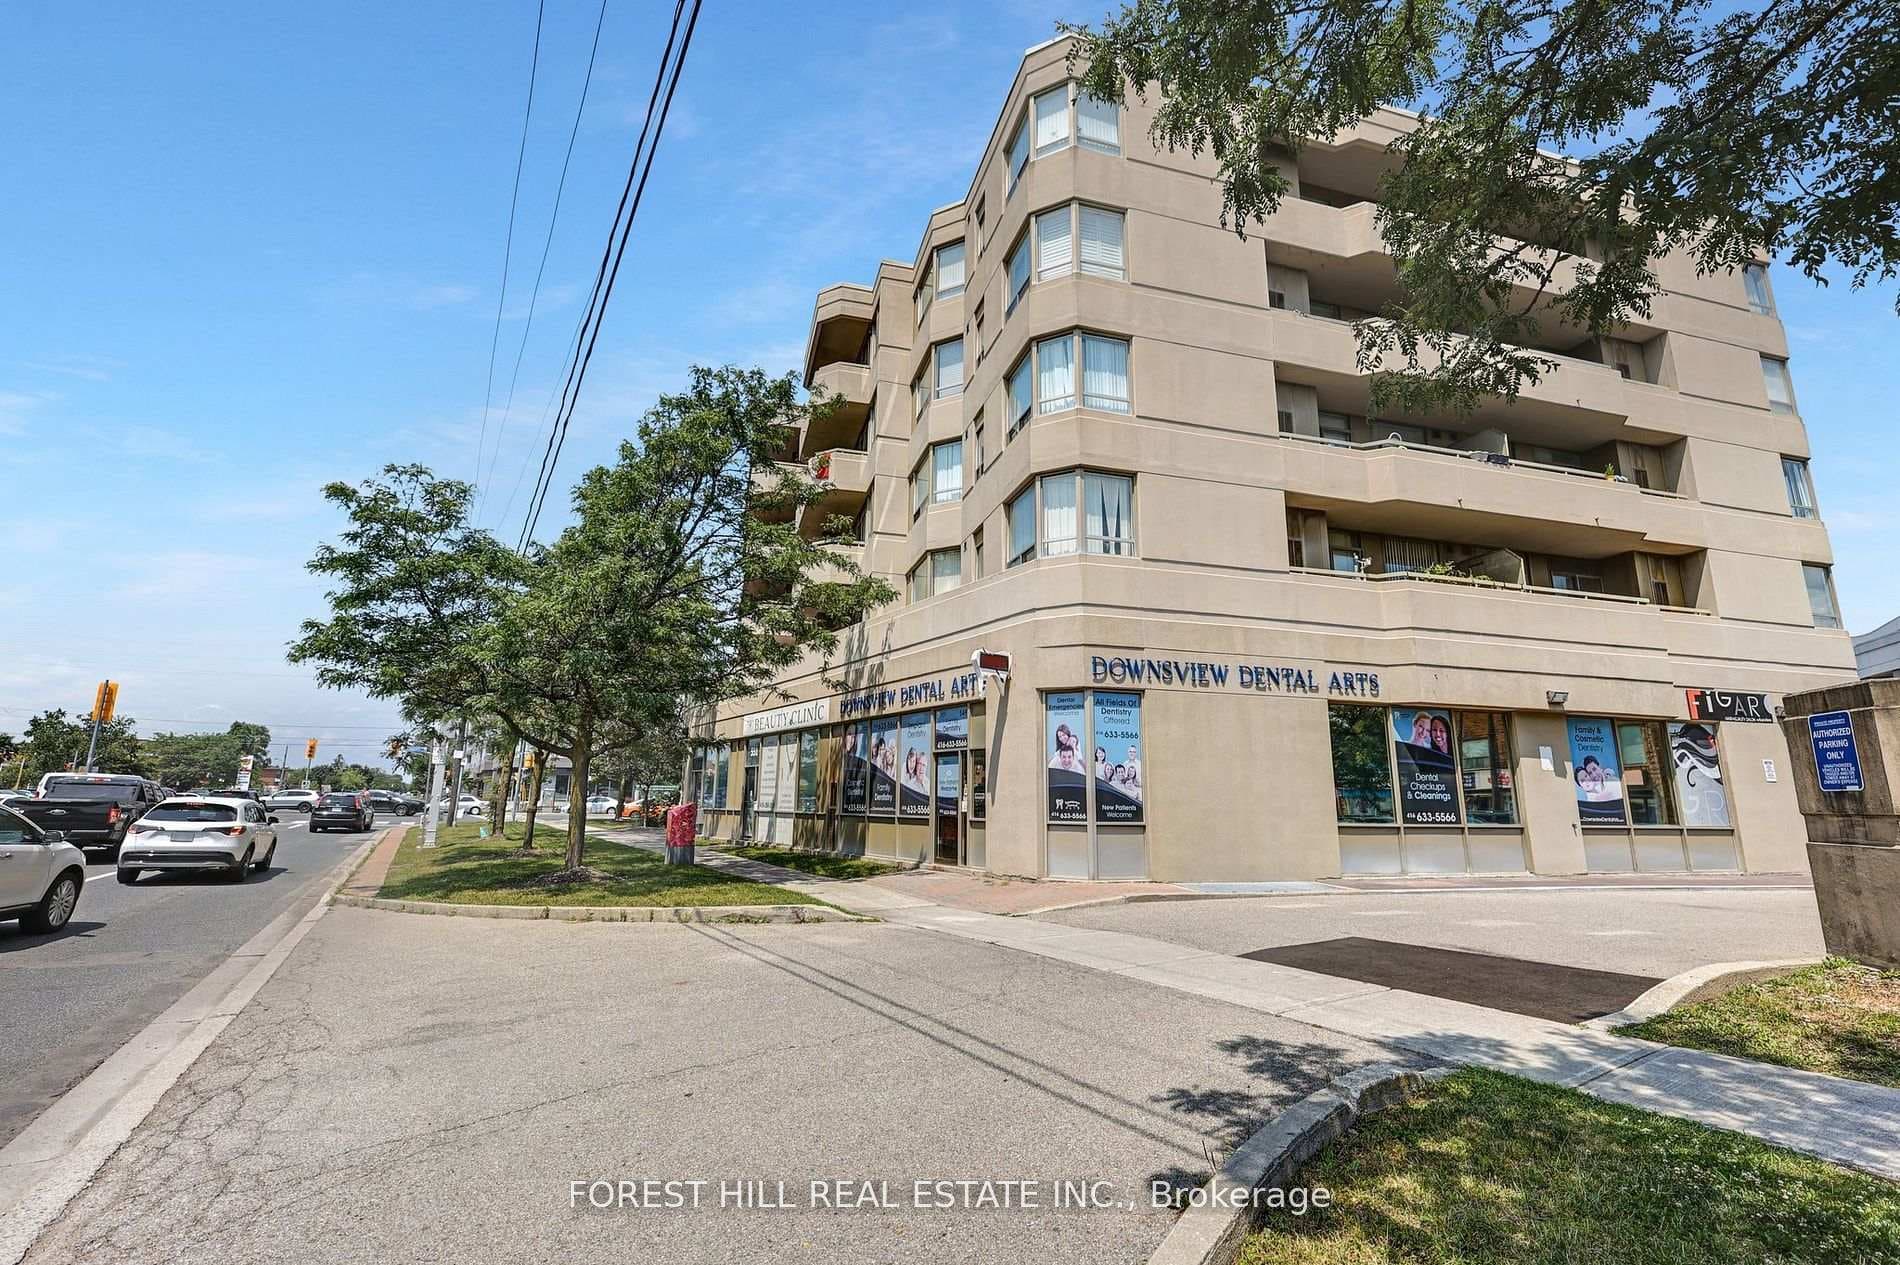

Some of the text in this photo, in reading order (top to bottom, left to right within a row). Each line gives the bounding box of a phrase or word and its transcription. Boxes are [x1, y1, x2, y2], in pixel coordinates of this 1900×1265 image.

[1092, 656, 1379, 693] DOWNSVIEW DENTAL ARTS
[840, 673, 986, 714] DOWNSVIEW DENTAL ART
[1106, 699, 1126, 707] Fields
[1101, 707, 1132, 716] Dentistry
[754, 711, 790, 731] BEAUTY
[791, 703, 825, 725] CLINIC
[1104, 731, 1139, 739] 633-5566
[1813, 727, 1851, 738] AUTHORIZED
[1818, 739, 1849, 749] PARKING
[1826, 751, 1845, 760] ONLY
[1416, 773, 1439, 781] Dental
[1410, 782, 1446, 791] Checkups
[1414, 791, 1451, 801] Cleanings
[907, 805, 930, 814] 633-5566
[1416, 812, 1456, 822] 633-5566
